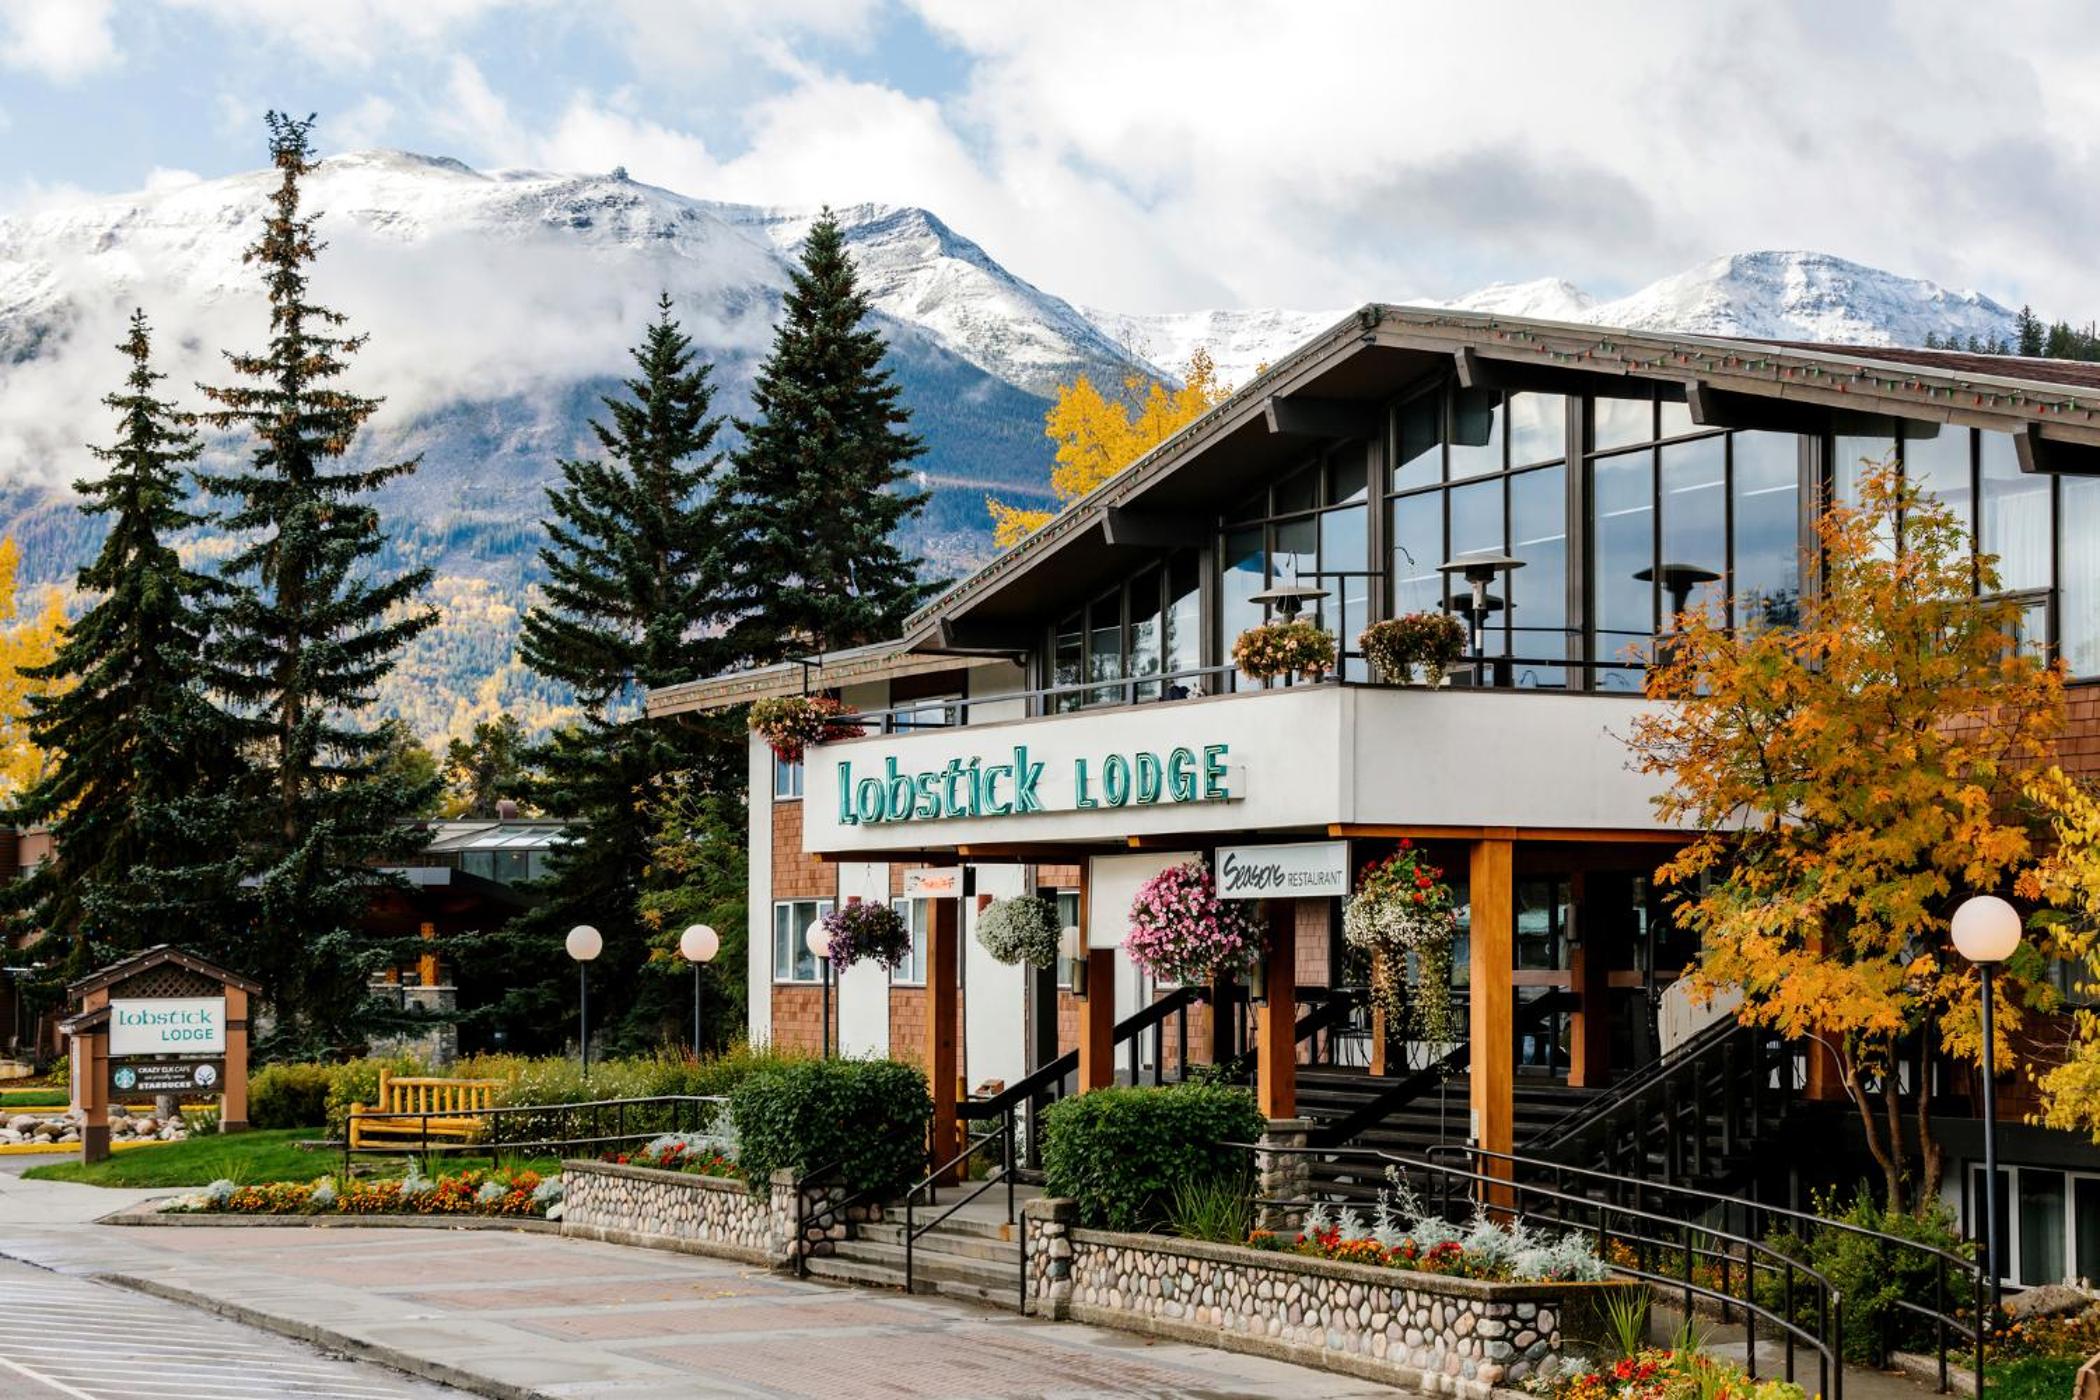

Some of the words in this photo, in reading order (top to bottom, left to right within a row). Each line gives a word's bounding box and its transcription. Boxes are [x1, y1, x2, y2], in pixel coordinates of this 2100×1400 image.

[838, 745, 1045, 826] Lobstick
[1075, 744, 1229, 810] LODGE
[1223, 852, 1286, 892] Seasons
[1287, 870, 1343, 888] RESTAURANT
[120, 1009, 213, 1025] Lobstick
[162, 1029, 213, 1041] LODGE
[138, 1081, 192, 1090] STARBUCKS
